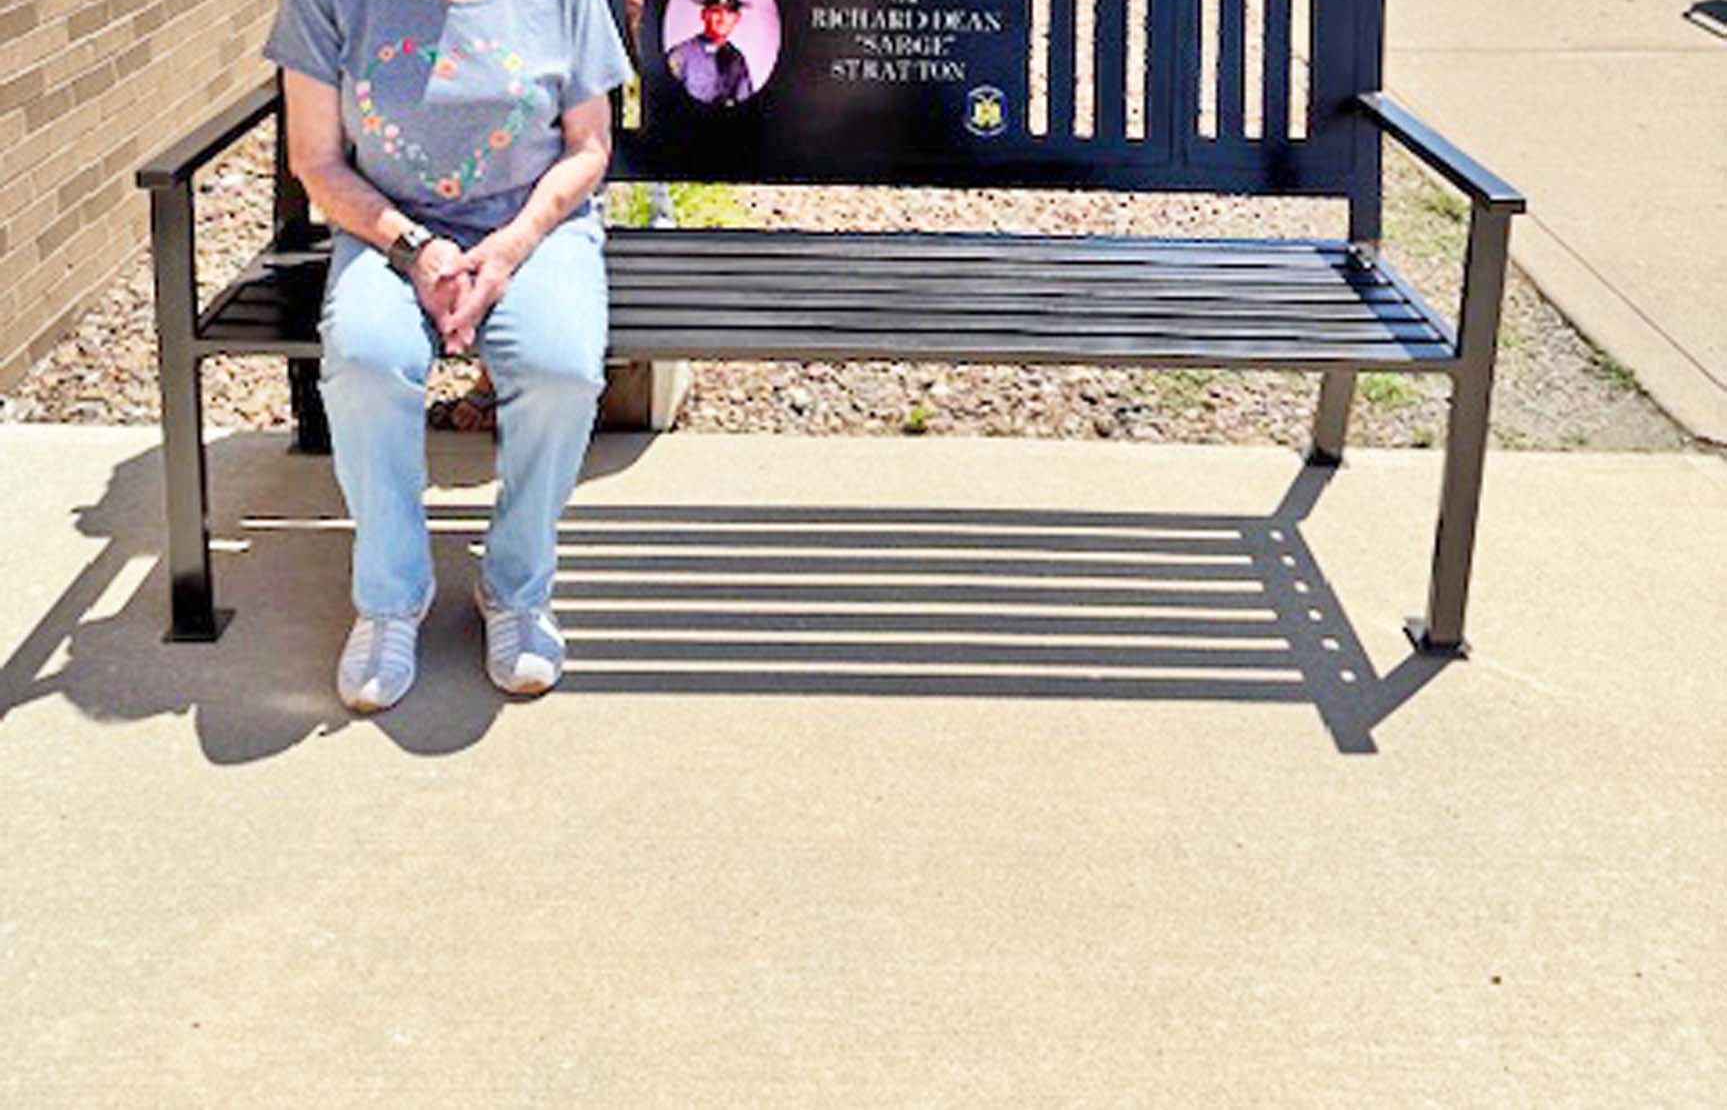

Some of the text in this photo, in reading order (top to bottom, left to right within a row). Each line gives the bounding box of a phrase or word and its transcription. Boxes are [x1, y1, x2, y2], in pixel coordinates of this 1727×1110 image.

[811, 7, 1003, 31] RICHARD DEAN
[830, 58, 966, 81] STRATTON
